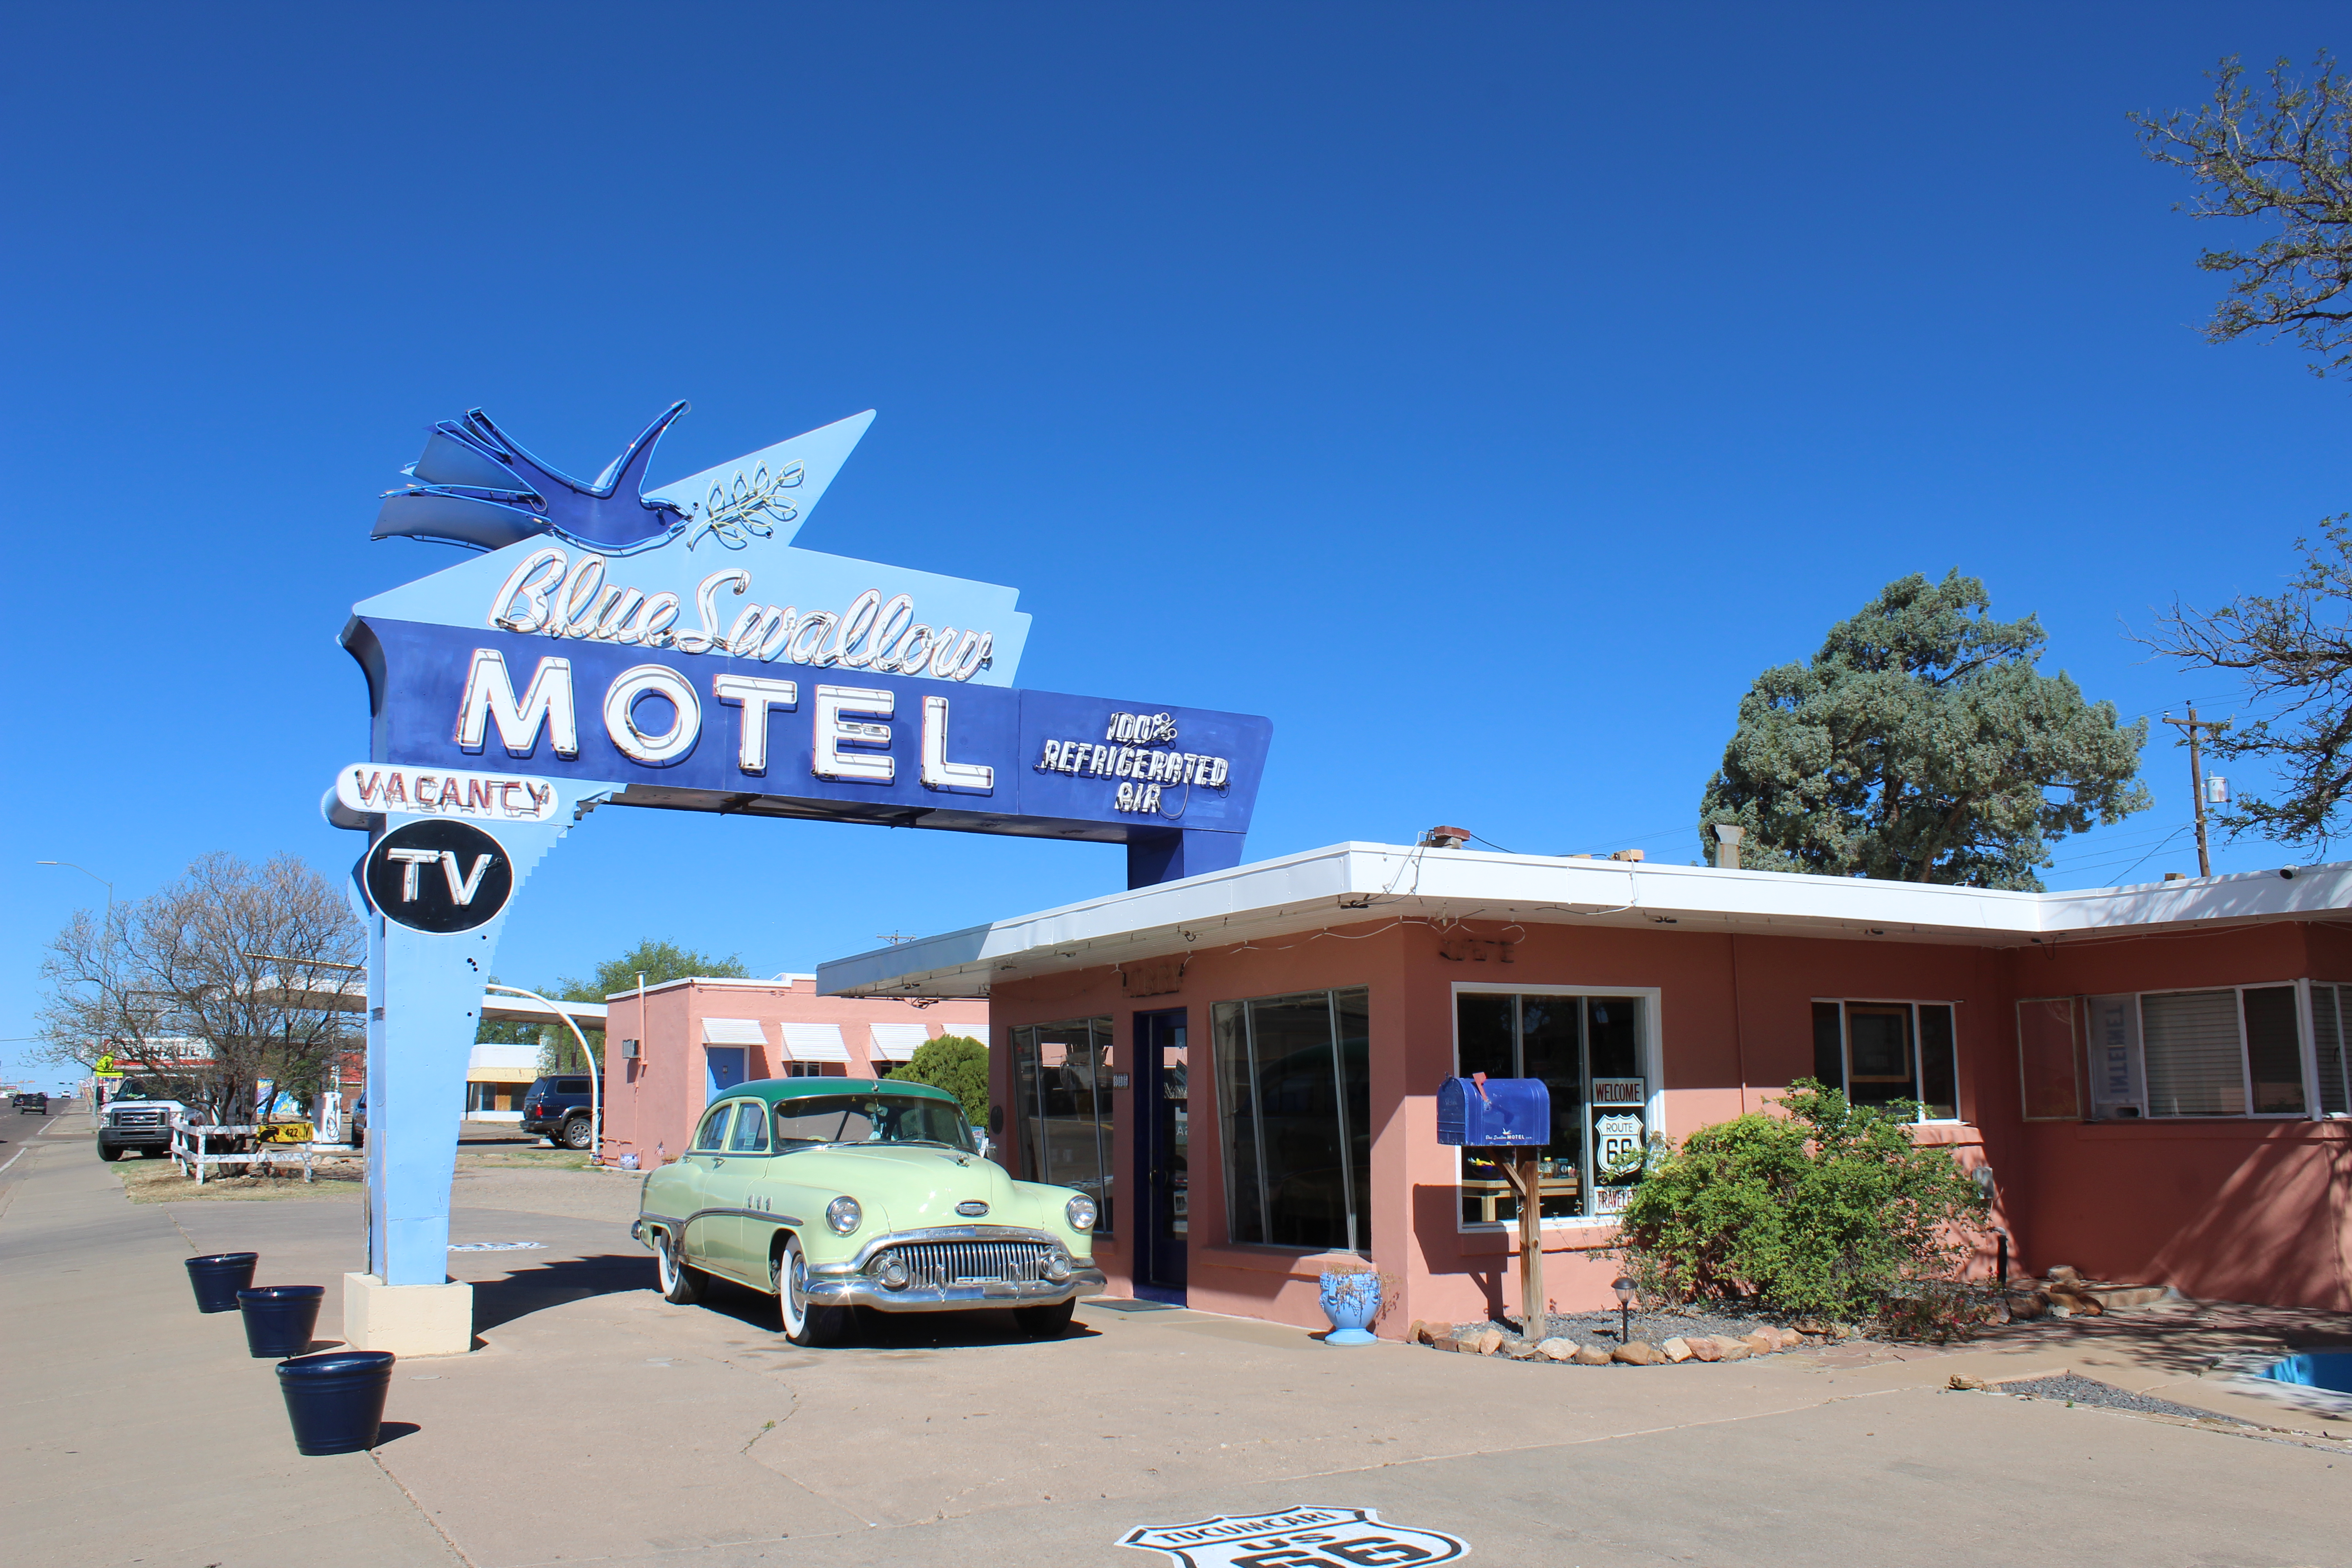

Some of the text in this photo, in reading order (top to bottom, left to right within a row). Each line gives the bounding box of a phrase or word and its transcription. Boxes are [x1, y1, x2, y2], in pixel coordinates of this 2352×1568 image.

[487, 547, 993, 681] Blue Swallow
[456, 648, 994, 790] MOTEL
[1106, 712, 1177, 743] 100%
[1041, 739, 1229, 786] REFRIGERATED
[355, 769, 550, 813] VACANCY
[1114, 782, 1161, 813] AIR
[388, 848, 493, 905] TV
[1113, 1074, 1128, 1087] 815
[1596, 1083, 1640, 1102] WELCOME
[285, 1128, 298, 1137] 422
[1606, 1123, 1633, 1132] ROUTE
[1152, 1511, 1338, 1543] TUCUMCARI
[1236, 1533, 1337, 1550] US
